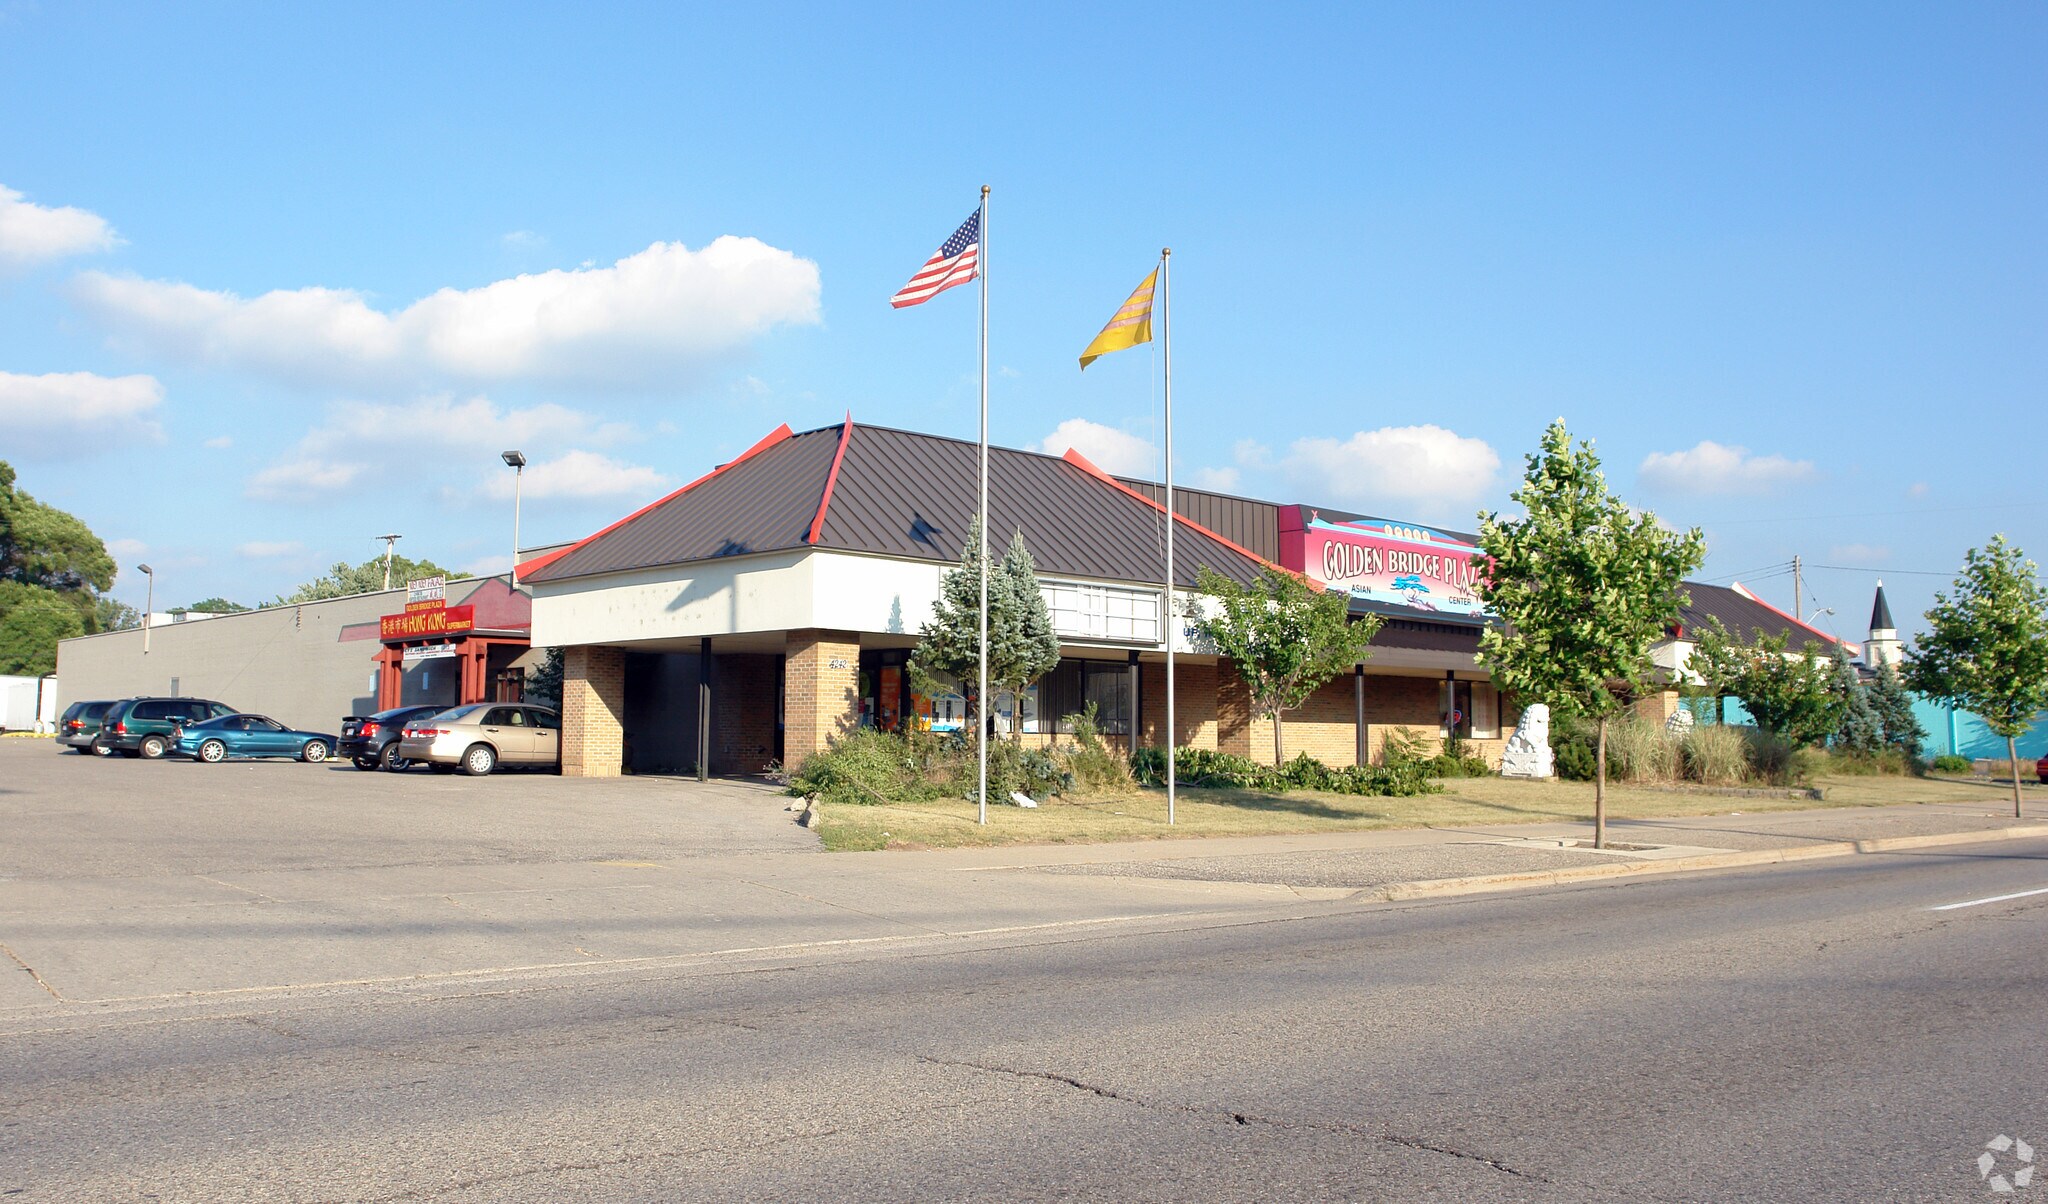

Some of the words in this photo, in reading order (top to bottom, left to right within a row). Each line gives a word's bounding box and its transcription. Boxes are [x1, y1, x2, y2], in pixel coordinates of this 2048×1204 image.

[1322, 539, 1384, 580] GOLDEN
[1388, 549, 1442, 581] BRIDGE
[1351, 584, 1372, 595] ASIAN
[407, 604, 418, 612] GOLDEN
[432, 601, 442, 609] PLAZA
[1449, 596, 1472, 606] CENTER
[409, 613, 426, 633] HONG
[428, 611, 447, 631] KONG
[447, 620, 471, 630] SUPERMARKET
[829, 659, 848, 669] 4242
